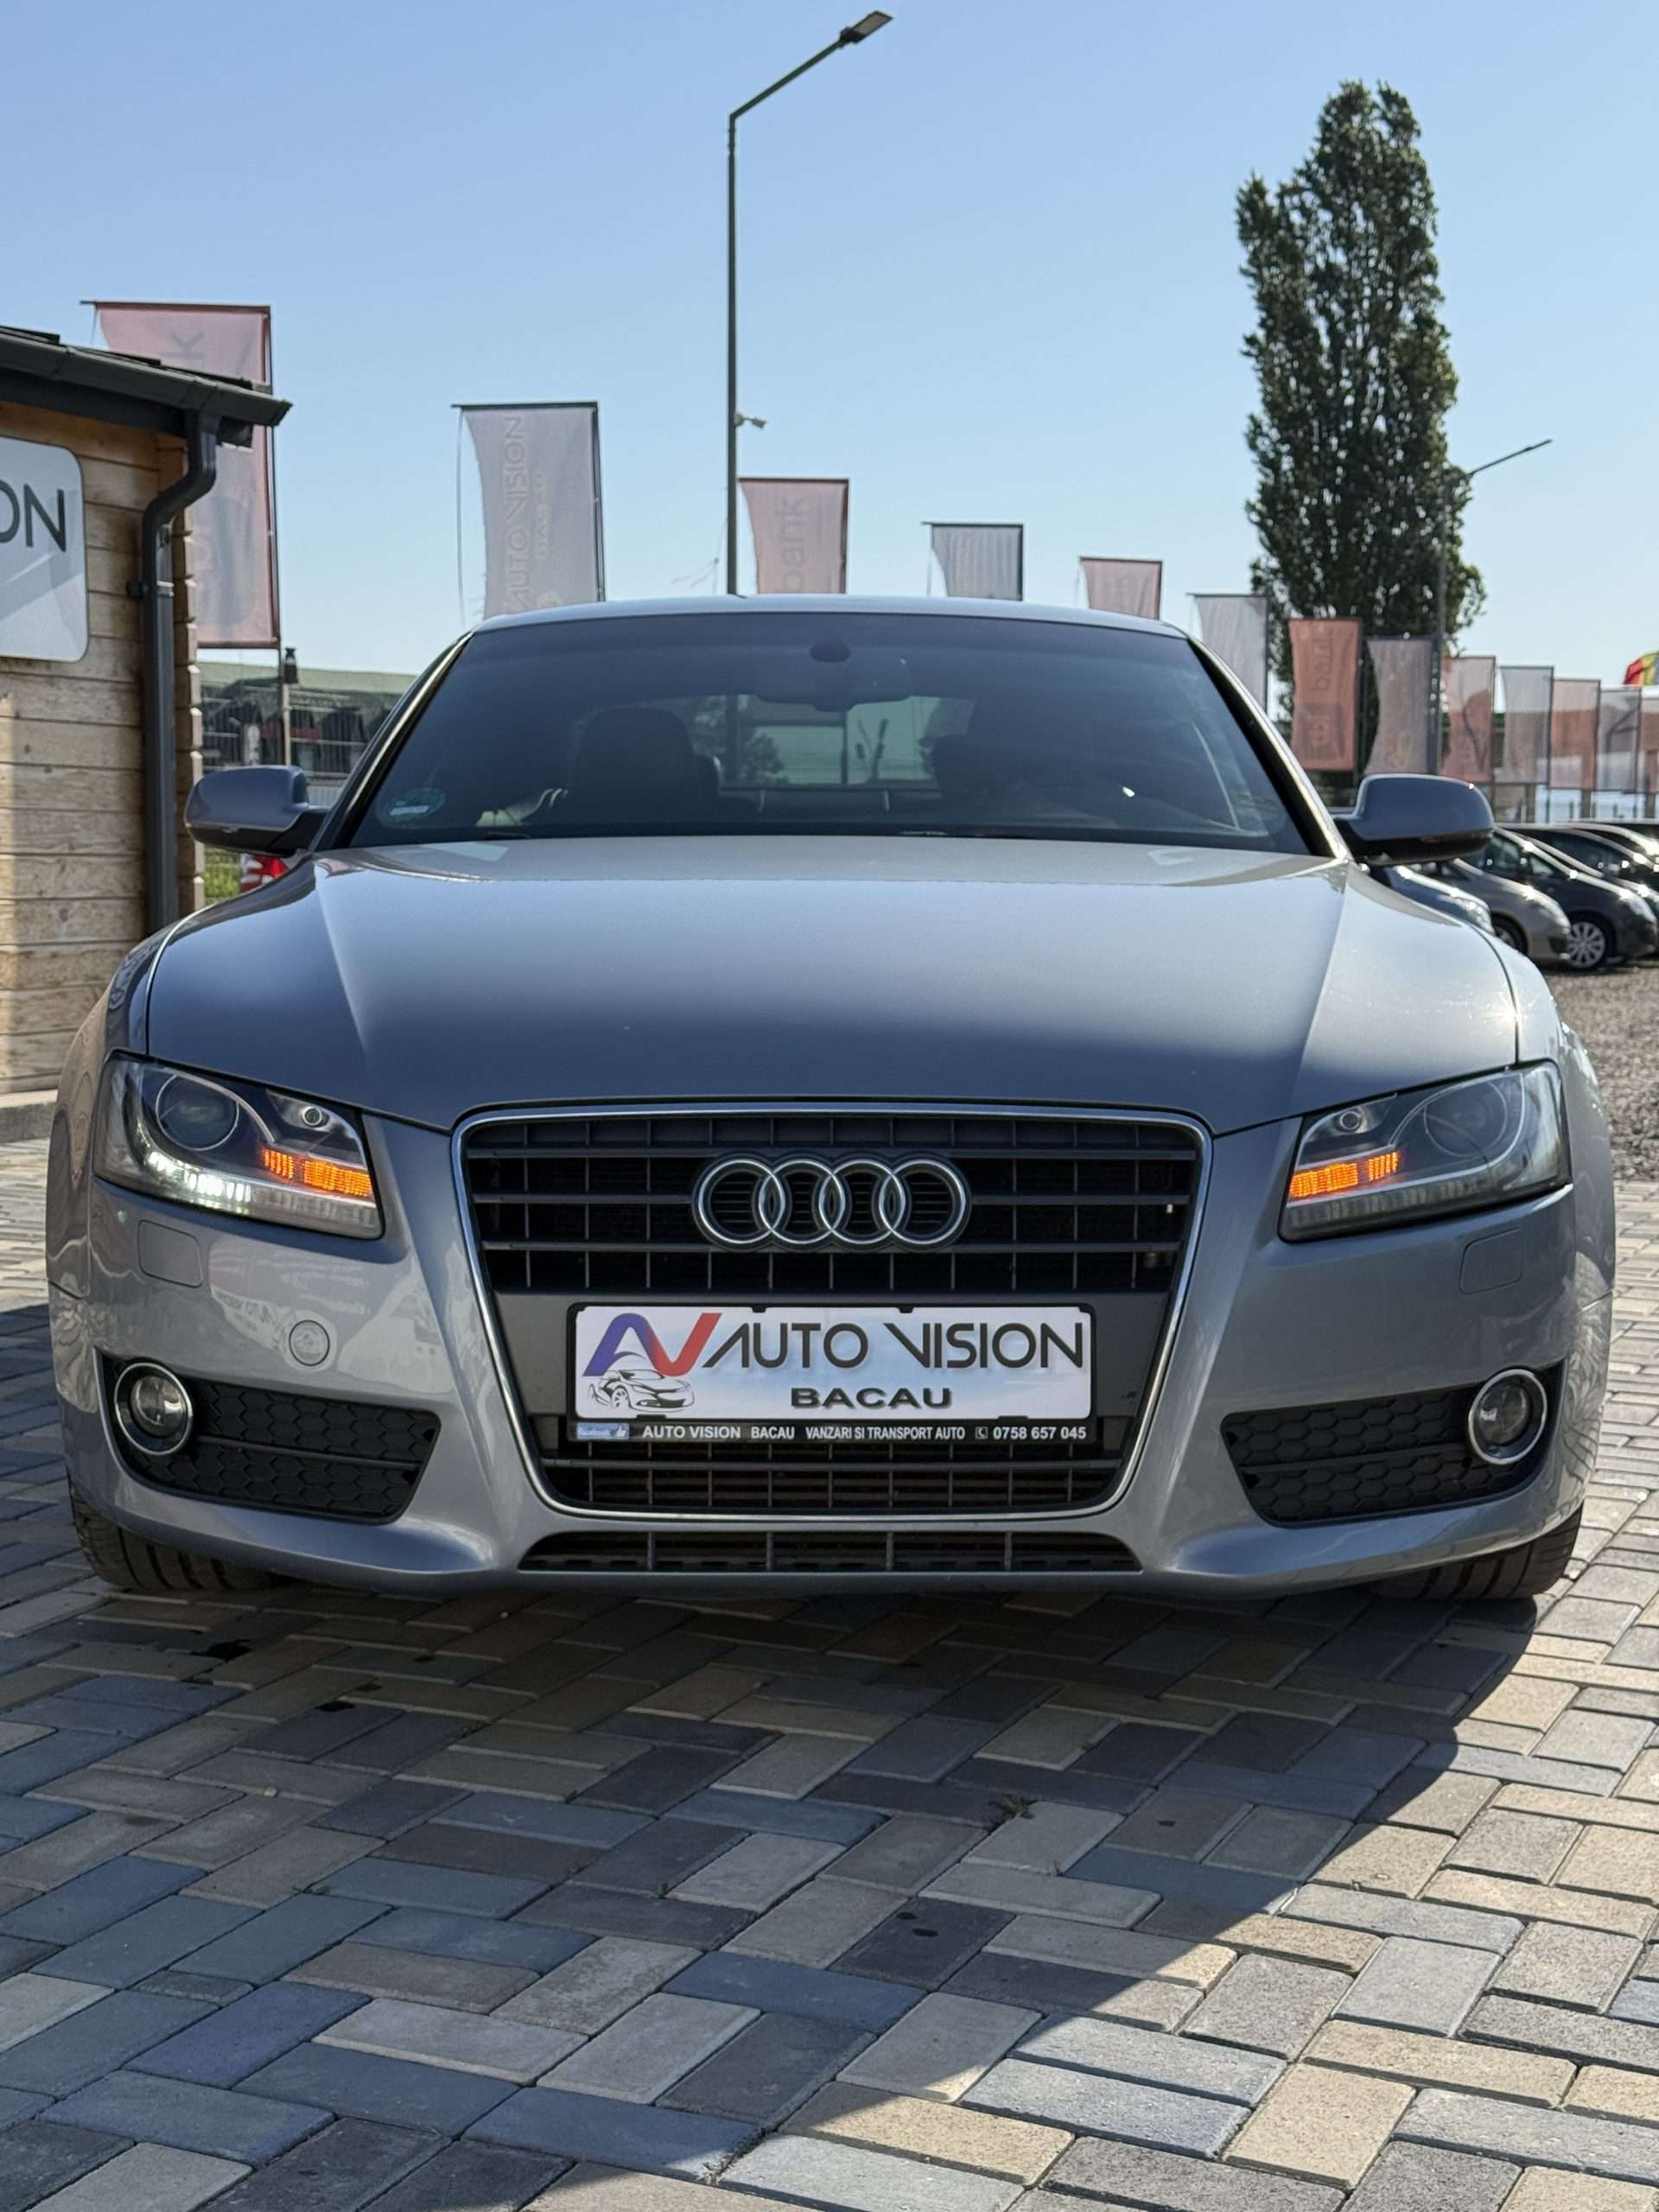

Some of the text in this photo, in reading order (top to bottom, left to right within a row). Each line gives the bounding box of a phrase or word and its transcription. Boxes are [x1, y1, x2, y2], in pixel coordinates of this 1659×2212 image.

[505, 416, 531, 609] AUTO VISION
[702, 1322, 1084, 1369] AUTO VISION
[790, 1387, 952, 1408] BACAU
[642, 1426, 685, 1439] AUTO
[690, 1426, 741, 1440] VISION
[751, 1426, 795, 1440] BACAU
[805, 1426, 852, 1440] VANZARI
[867, 1426, 934, 1440] TRANSPORT
[935, 1426, 965, 1440] AUTO
[993, 1426, 1027, 1440] 0758
[1031, 1426, 1056, 1440] 657
[1059, 1426, 1087, 1440] 045
